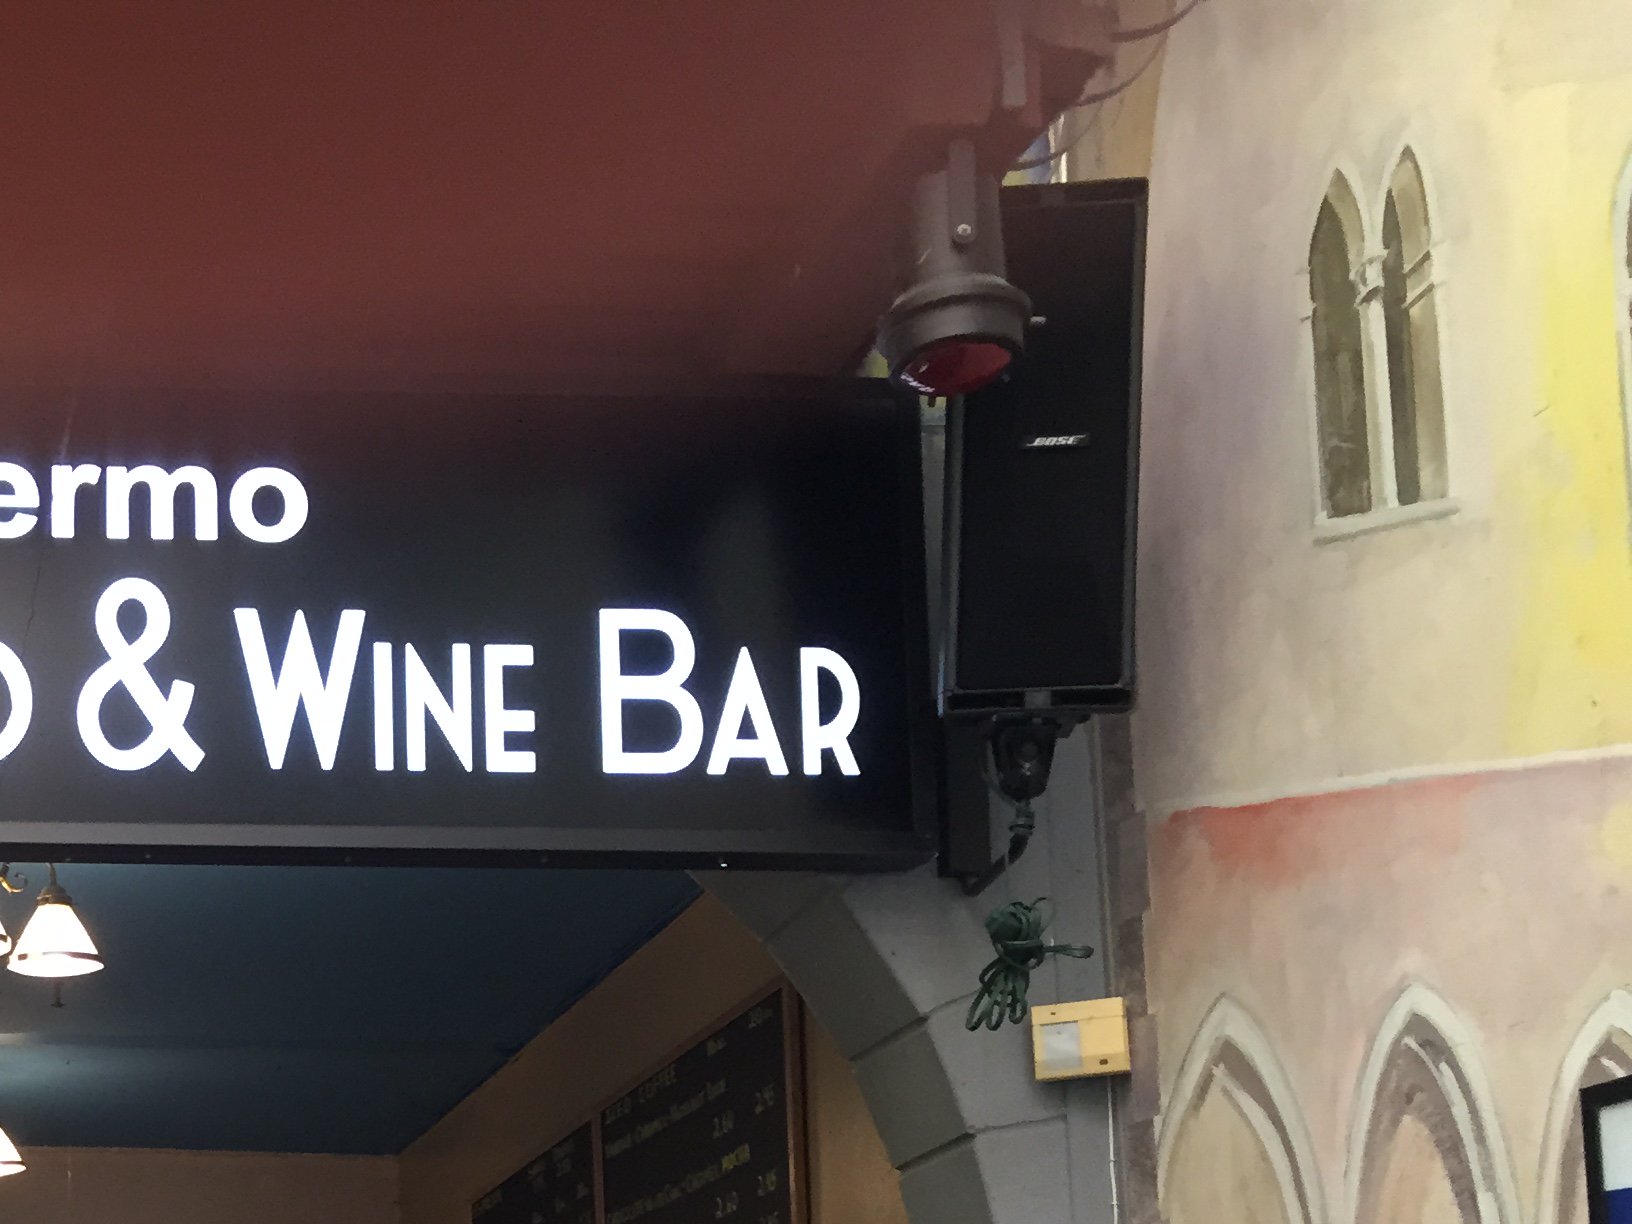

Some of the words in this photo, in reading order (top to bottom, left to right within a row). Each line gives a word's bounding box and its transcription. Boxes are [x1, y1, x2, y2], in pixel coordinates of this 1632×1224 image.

[1025, 434, 1087, 447] BOSE
[75, 576, 206, 773] &
[232, 607, 537, 773] WINE
[598, 608, 861, 776] BAR
